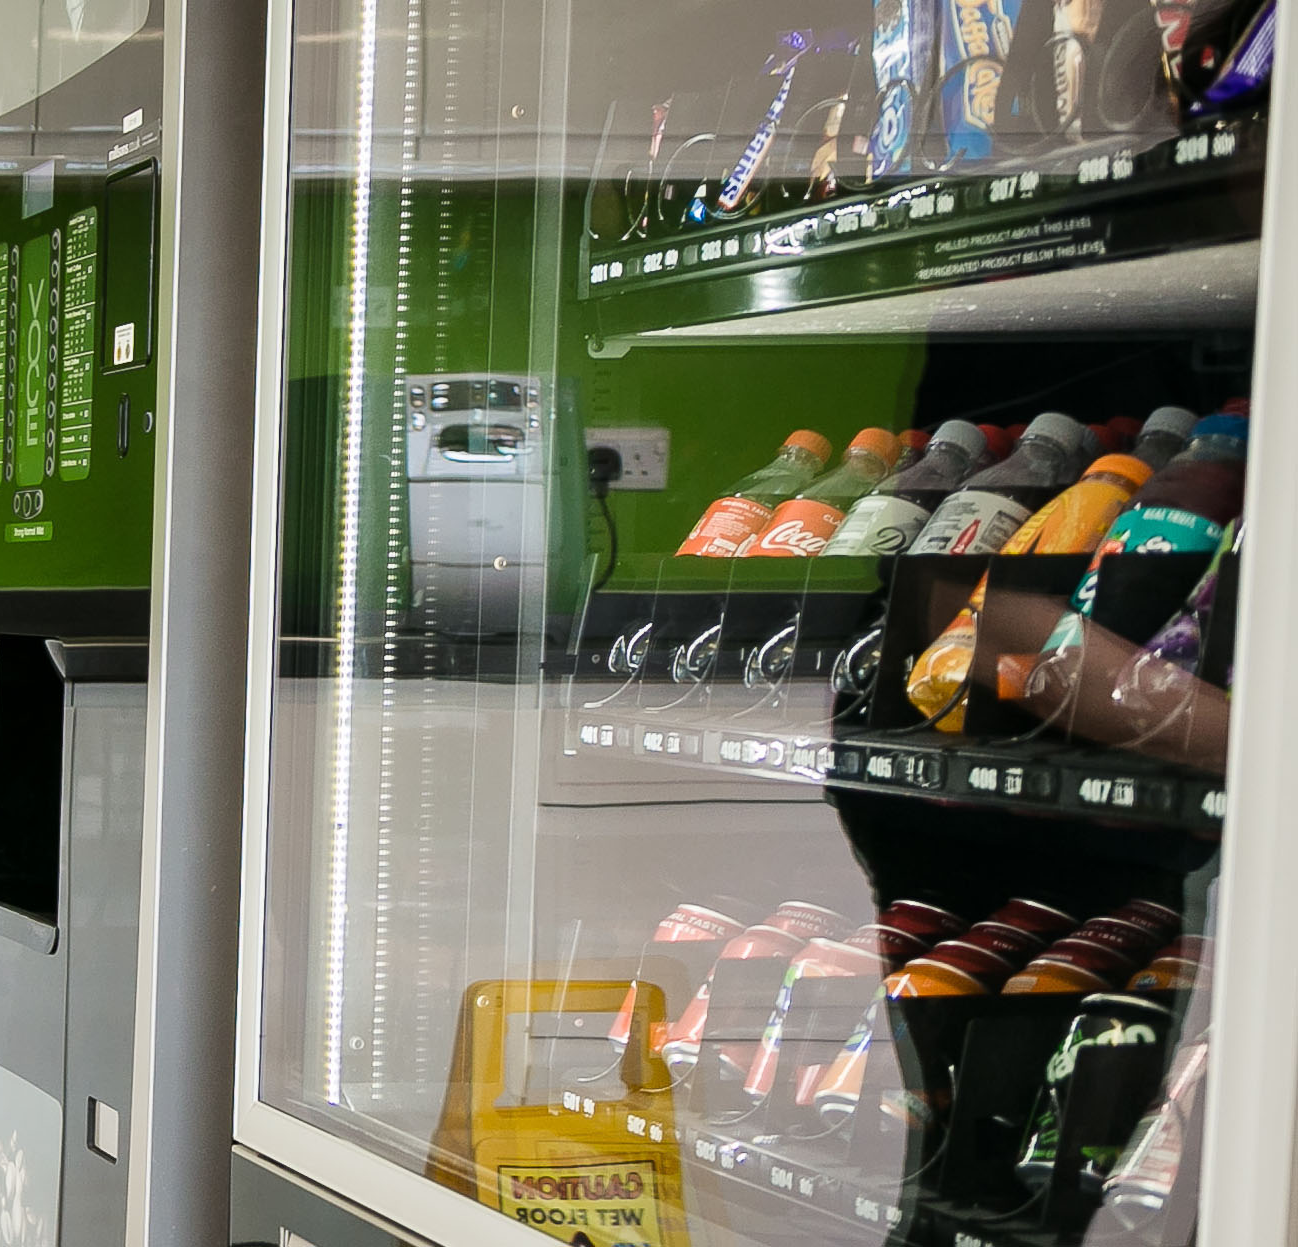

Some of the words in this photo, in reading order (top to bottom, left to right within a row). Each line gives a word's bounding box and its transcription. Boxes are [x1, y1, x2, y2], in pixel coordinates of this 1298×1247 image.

[26, 278, 45, 447] VOCE
[867, 755, 892, 778] 405
[1079, 779, 1112, 803] 407
[1202, 791, 1226, 817] 40
